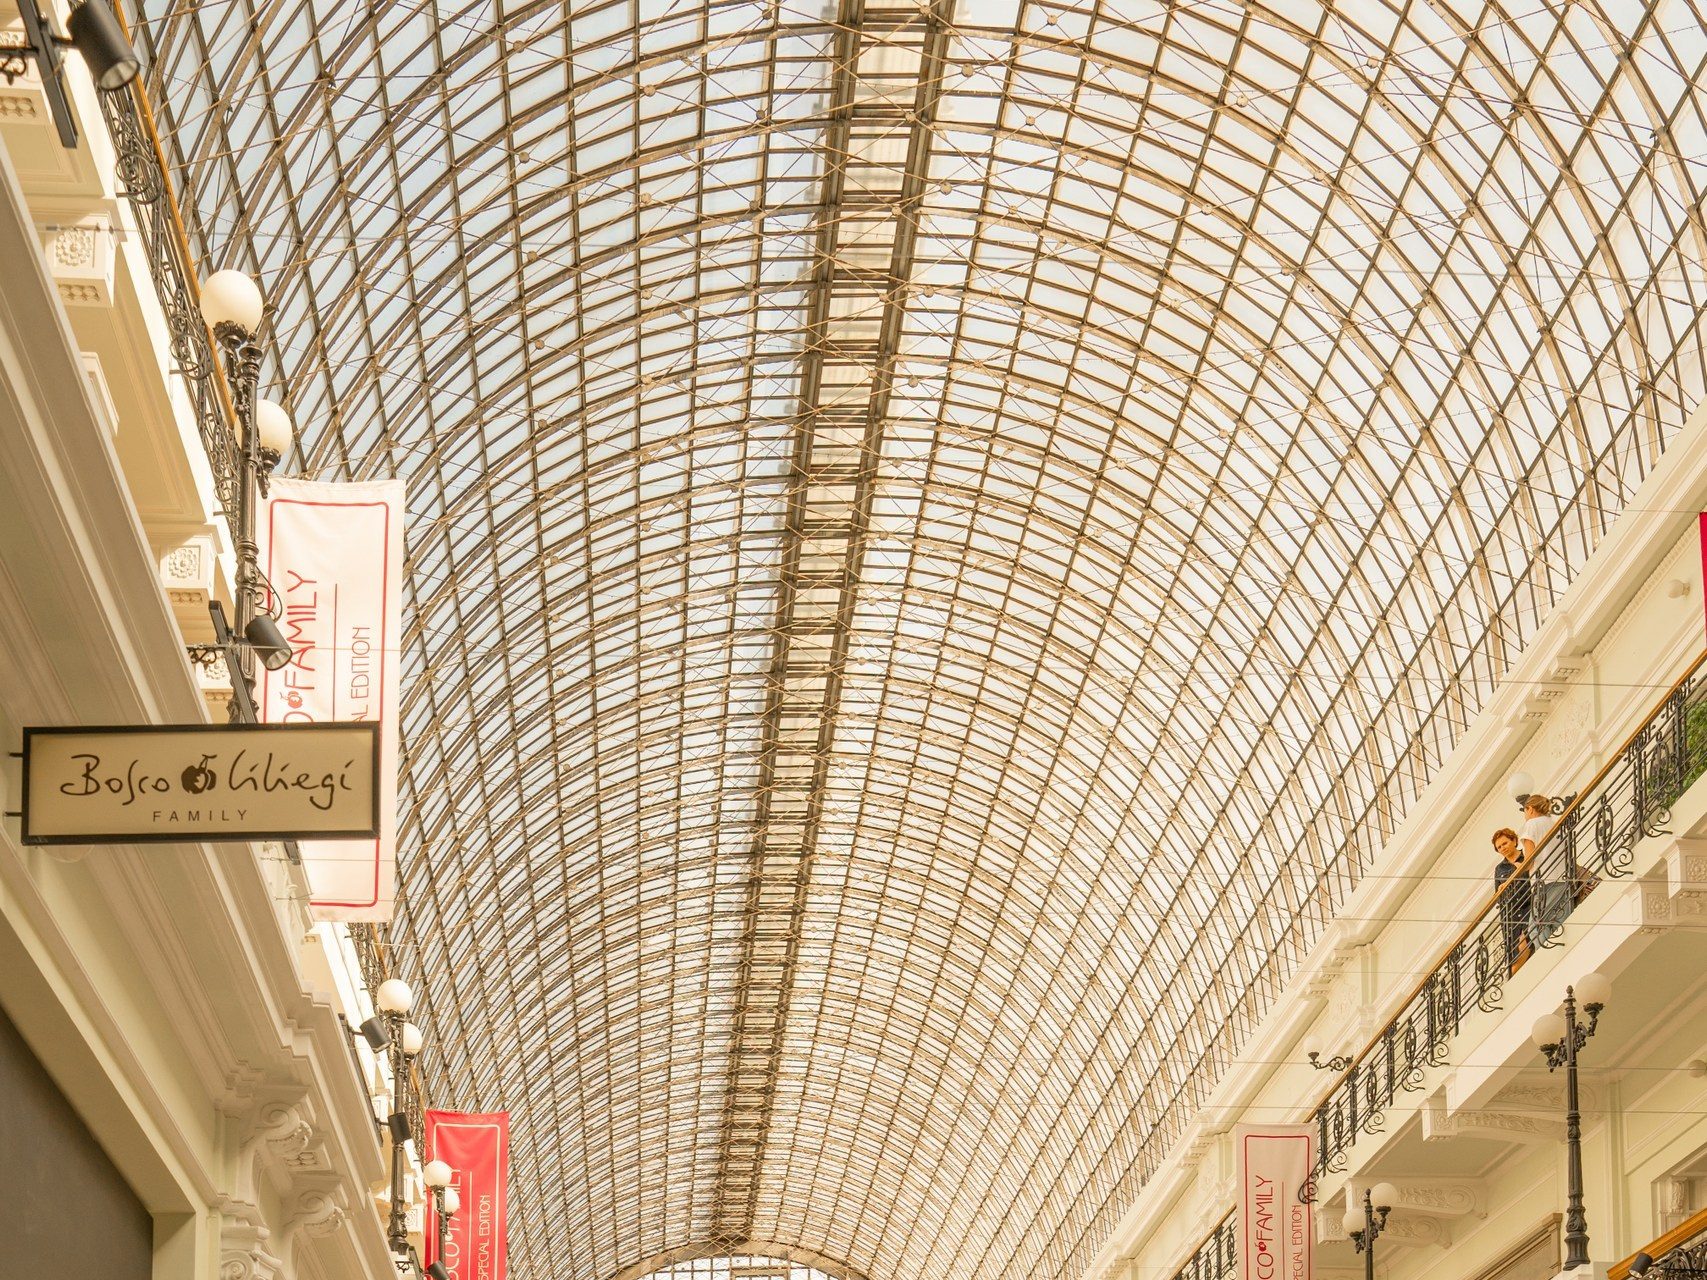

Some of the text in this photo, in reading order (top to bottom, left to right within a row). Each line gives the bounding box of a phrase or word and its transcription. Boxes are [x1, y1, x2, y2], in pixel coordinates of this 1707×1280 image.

[284, 569, 318, 691] FAMILY
[350, 626, 371, 704] EDITION
[60, 753, 170, 806] Bosco
[152, 809, 248, 822] FAMILY
[478, 1194, 491, 1237] EDITION
[1255, 1175, 1274, 1242] FAMILY
[1291, 1204, 1303, 1246] EDITION
